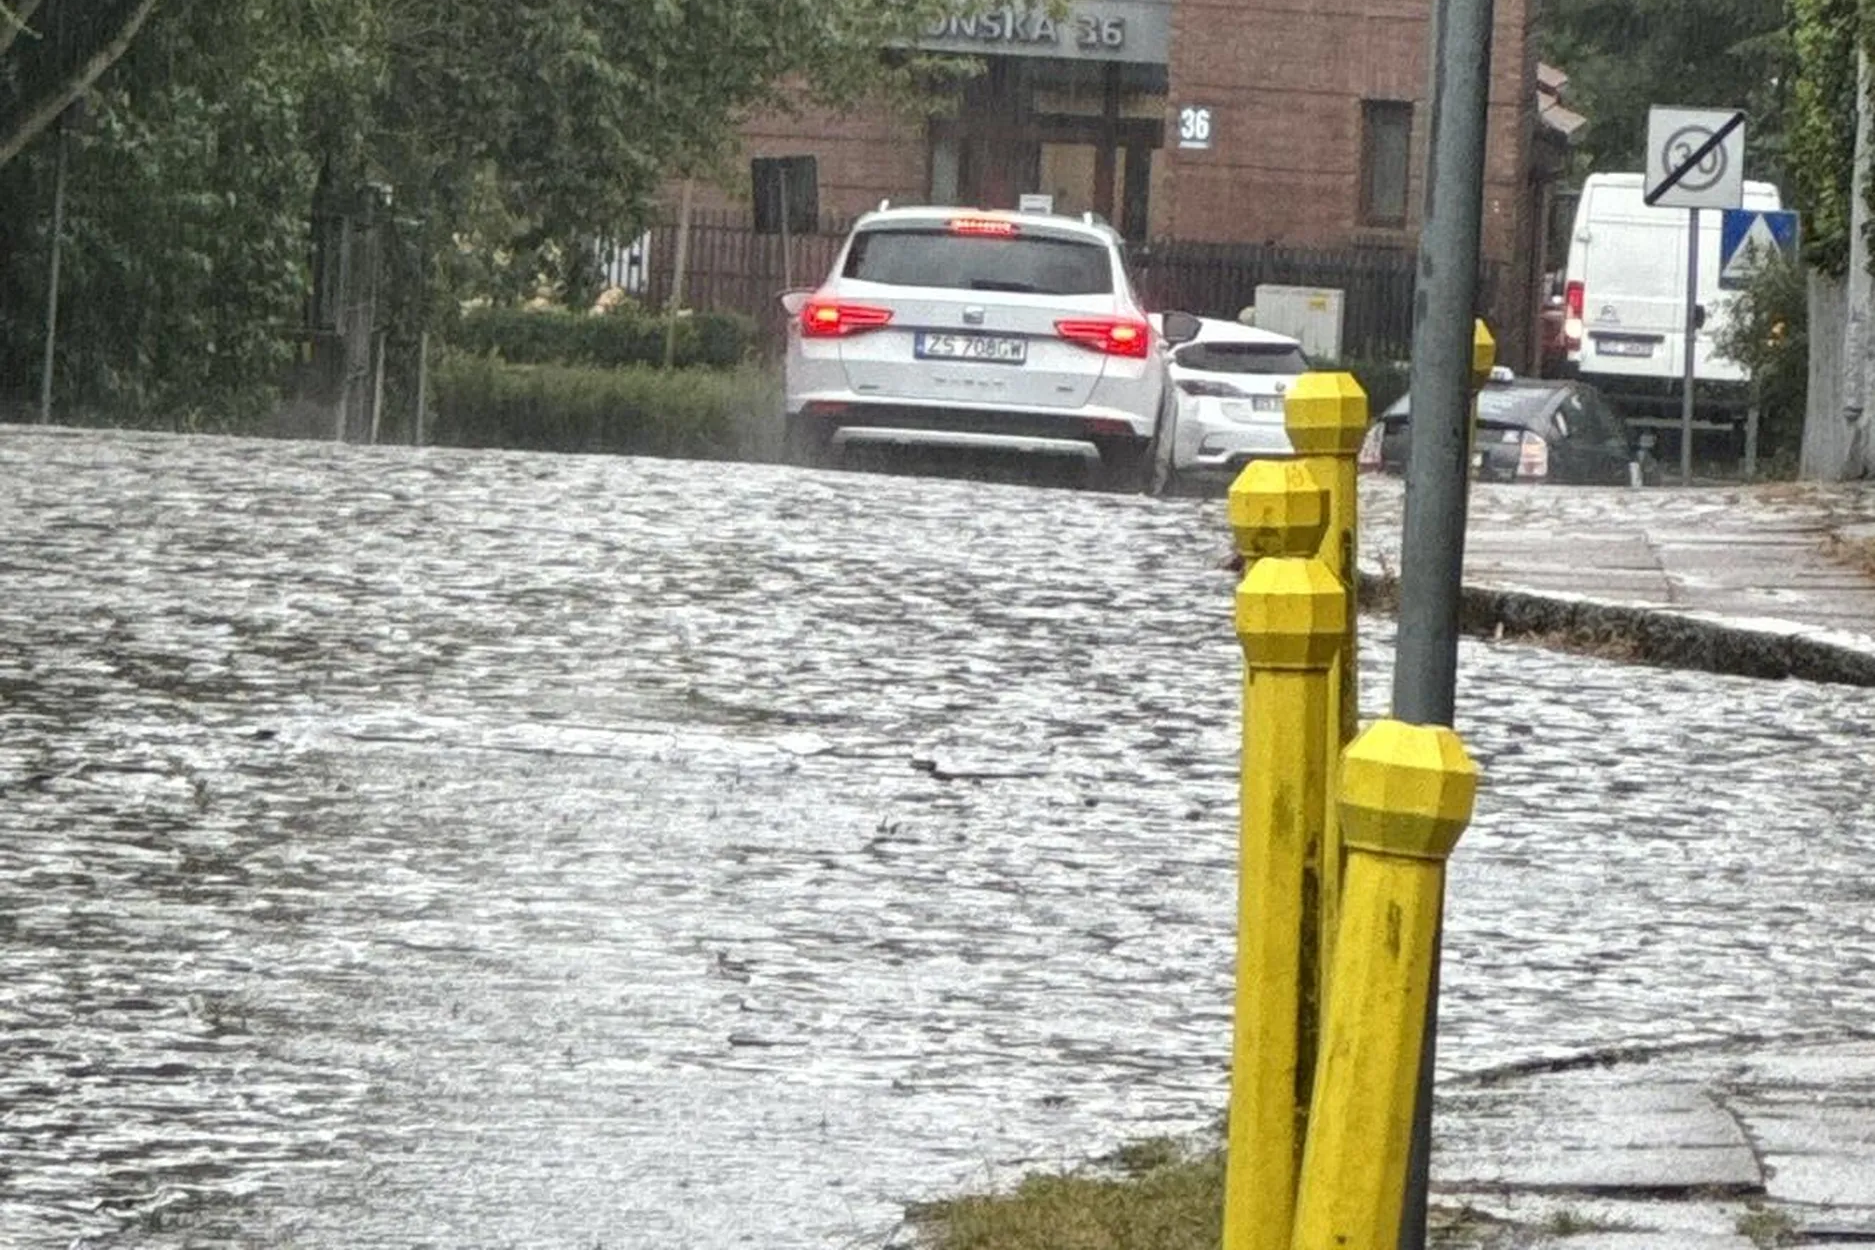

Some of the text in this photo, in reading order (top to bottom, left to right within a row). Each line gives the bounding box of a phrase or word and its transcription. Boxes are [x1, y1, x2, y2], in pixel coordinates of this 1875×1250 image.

[1076, 14, 1125, 50] 36
[1180, 107, 1210, 140] 36
[1675, 141, 1718, 175] 30
[927, 335, 955, 355] ZS
